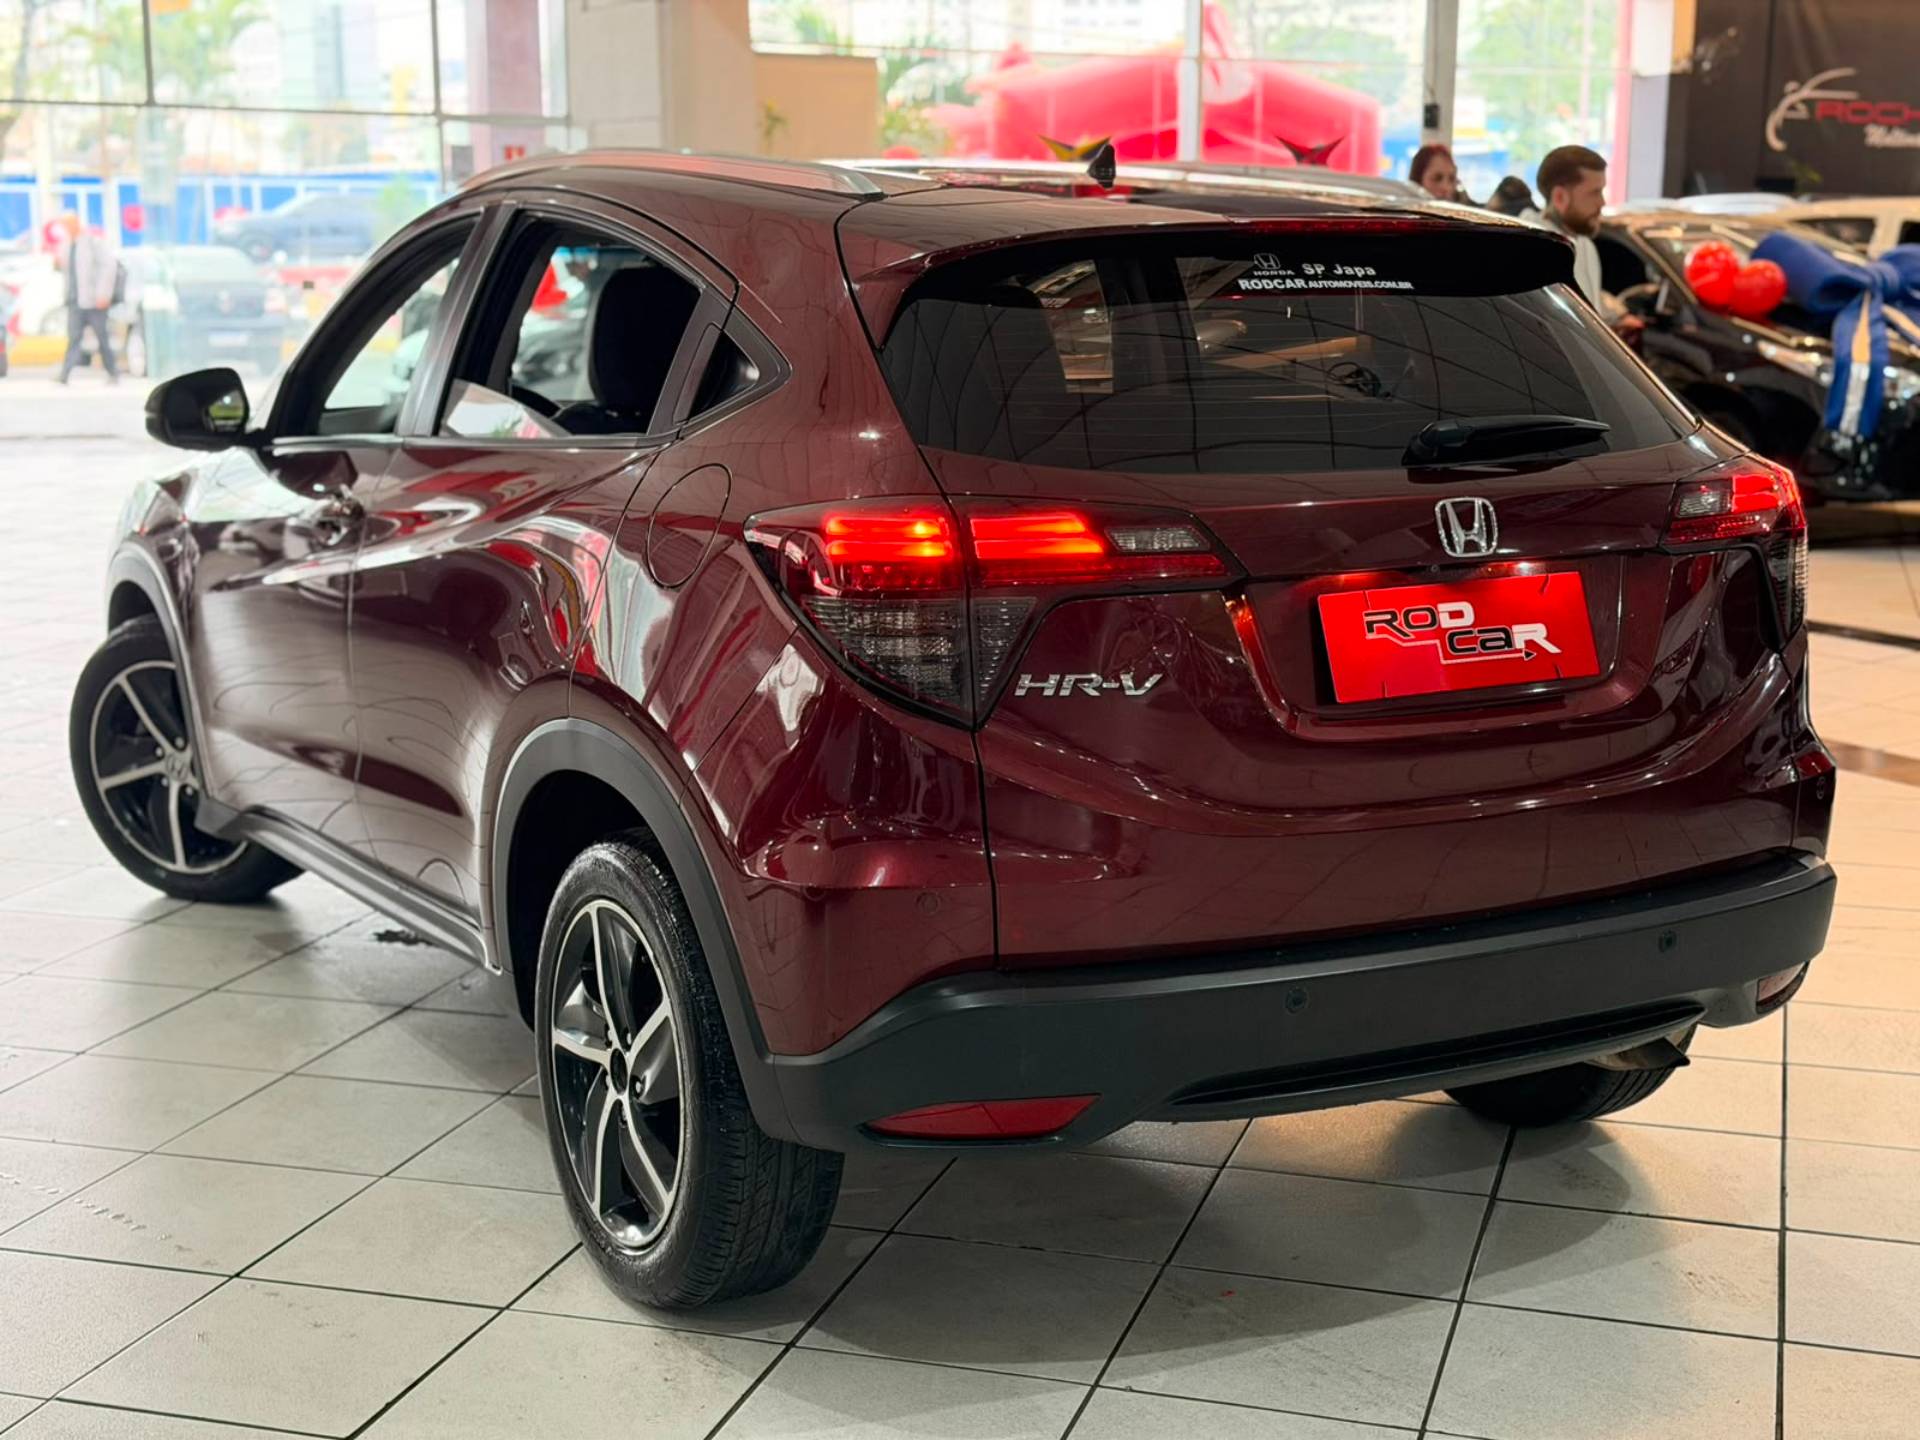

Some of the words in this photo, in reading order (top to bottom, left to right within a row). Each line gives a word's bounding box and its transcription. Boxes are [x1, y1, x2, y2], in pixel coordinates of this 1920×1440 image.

[1302, 263, 1326, 276] SP
[1333, 264, 1377, 278] Japa
[1238, 278, 1308, 290] RODCAR
[1363, 601, 1475, 639] ROD
[1014, 673, 1163, 696] HR-V
